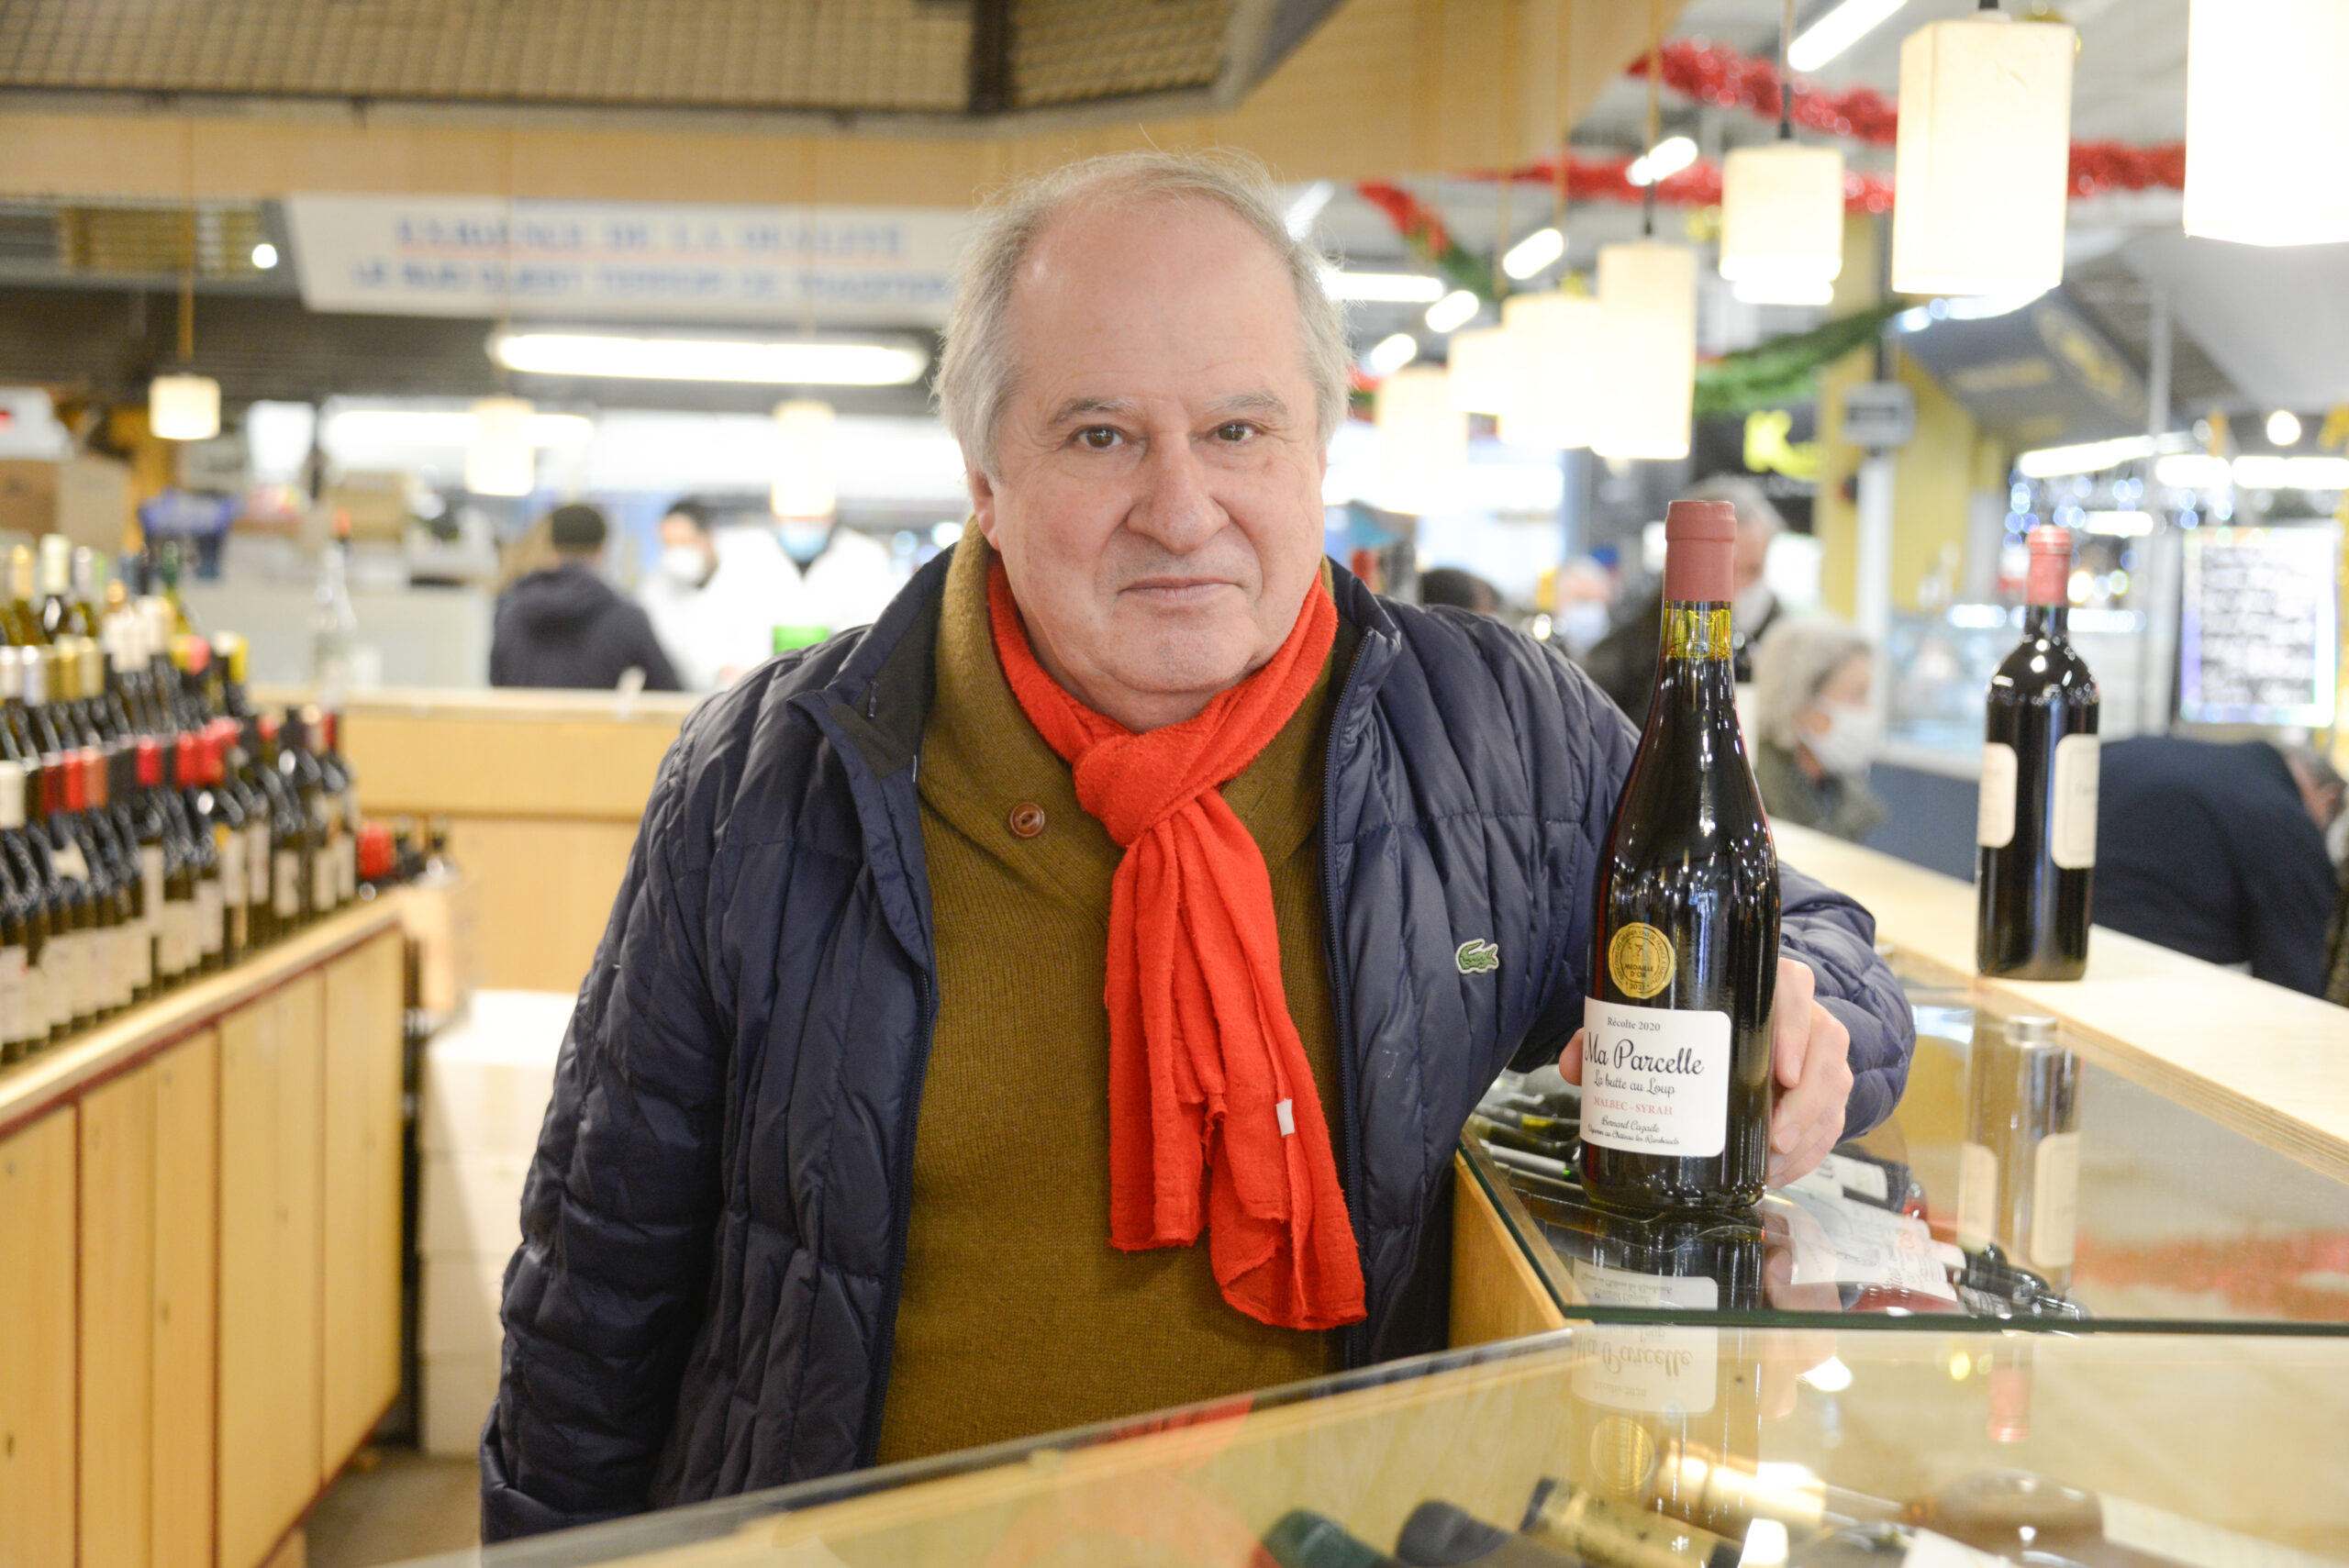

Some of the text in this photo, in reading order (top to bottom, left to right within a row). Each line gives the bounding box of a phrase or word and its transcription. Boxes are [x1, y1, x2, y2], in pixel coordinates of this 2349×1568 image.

[1607, 1016, 1661, 1032] Récolte 2020
[1585, 1031, 1705, 1074] Ma Parcelle
[1594, 1069, 1675, 1097] La butte au Loup
[1594, 1095, 1628, 1111] MALBEC
[1635, 1103, 1674, 1116] SYRAH
